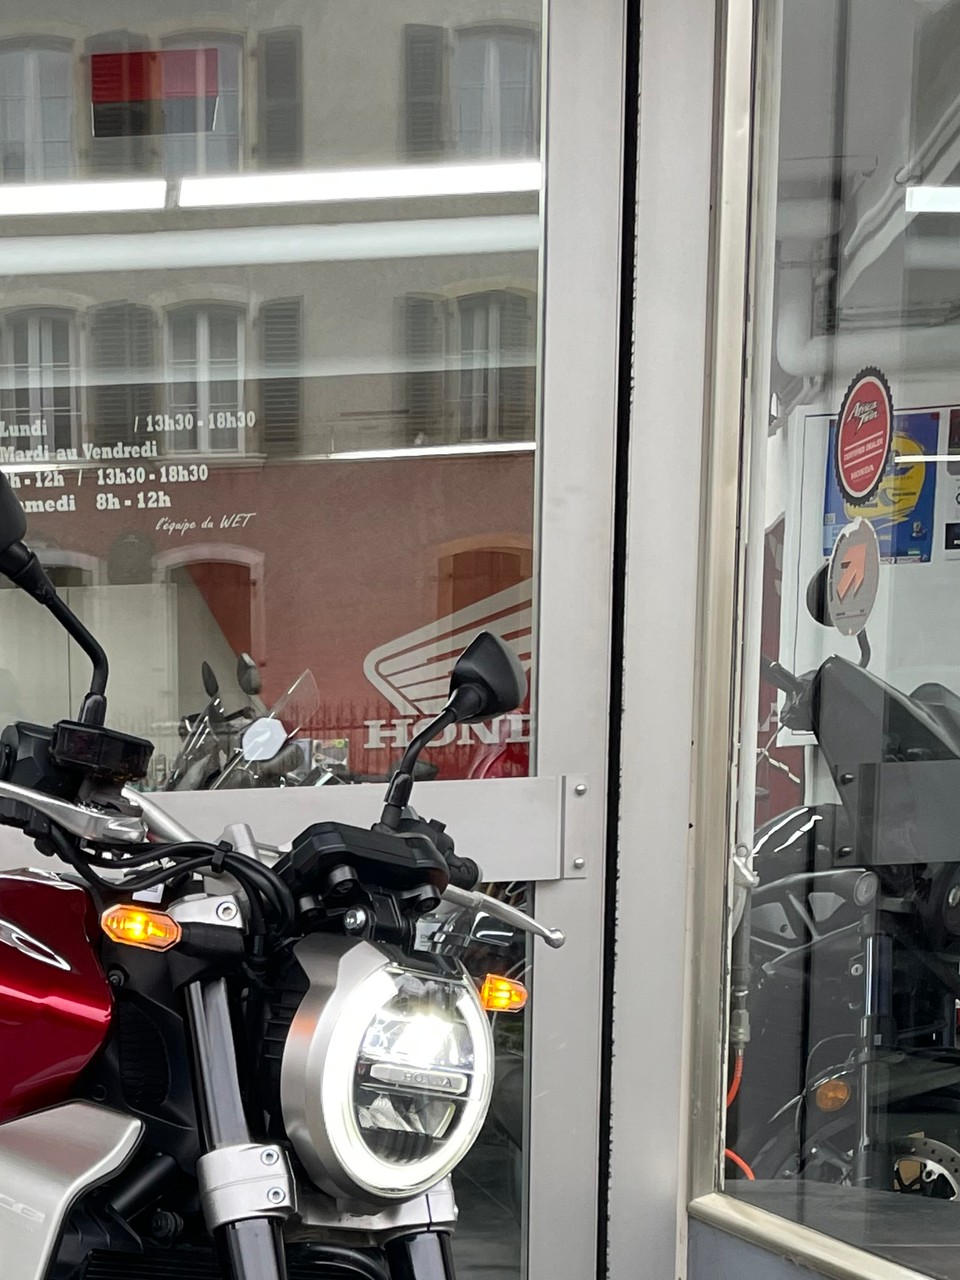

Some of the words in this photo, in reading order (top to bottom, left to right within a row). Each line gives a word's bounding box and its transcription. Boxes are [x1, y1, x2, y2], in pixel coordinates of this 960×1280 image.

[0, 444, 50, 464] Mardi
[56, 448, 78, 462] au
[82, 440, 158, 460] Vendredi
[7, 471, 22, 488] h
[18, 494, 77, 513] medi
[96, 492, 121, 511] 8h
[136, 490, 172, 509] 12h
[155, 516, 197, 536] l'équipe
[201, 518, 215, 530] du
[219, 512, 257, 529] WET
[403, 1072, 453, 1088] HOA
